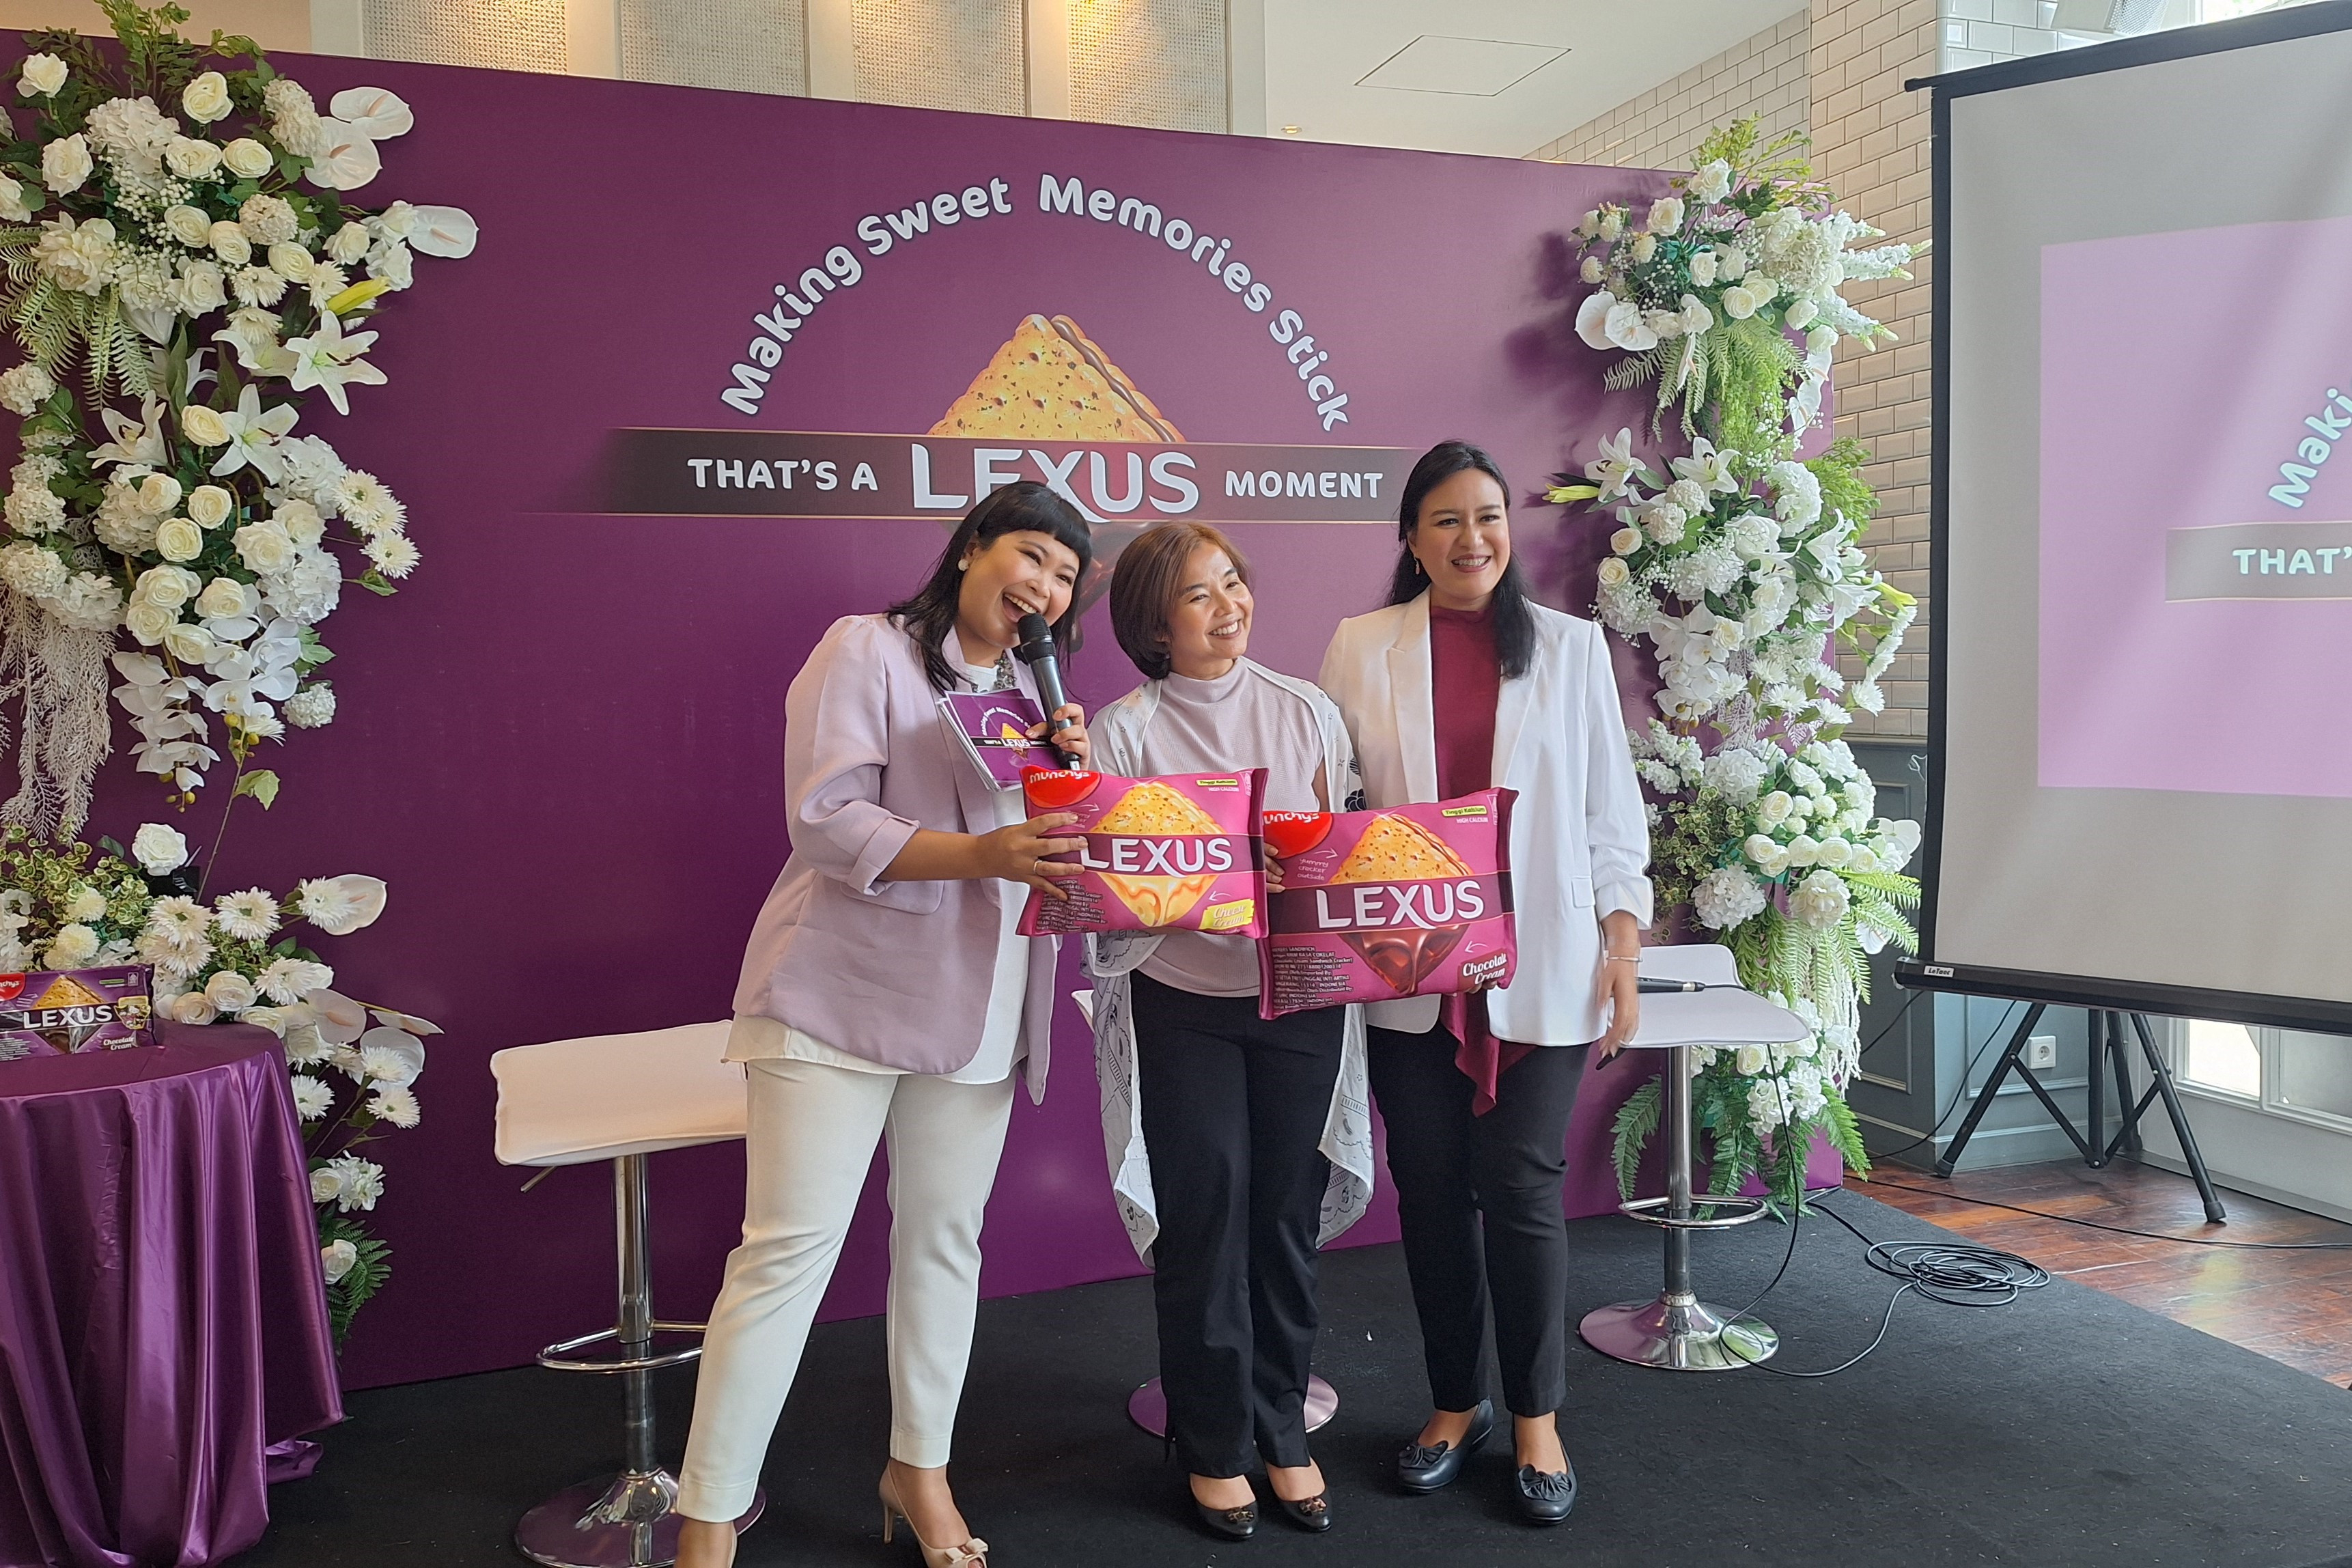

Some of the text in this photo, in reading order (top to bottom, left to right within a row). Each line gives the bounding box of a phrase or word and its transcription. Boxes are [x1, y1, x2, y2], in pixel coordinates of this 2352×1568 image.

[721, 173, 1349, 432] Making Sweet Memories Stick
[2268, 380, 2352, 508] Maki
[687, 443, 1384, 524] THAT'S A LEXUS MOMENT
[2232, 546, 2352, 575] THAT'
[1001, 738, 1031, 748] LEXUS
[1263, 812, 1320, 824] unchys
[1078, 836, 1233, 878] LEXUS
[1315, 880, 1485, 929] LEXUS
[23, 1005, 112, 1029] LEXUS
[103, 1037, 135, 1046] Chocolate
